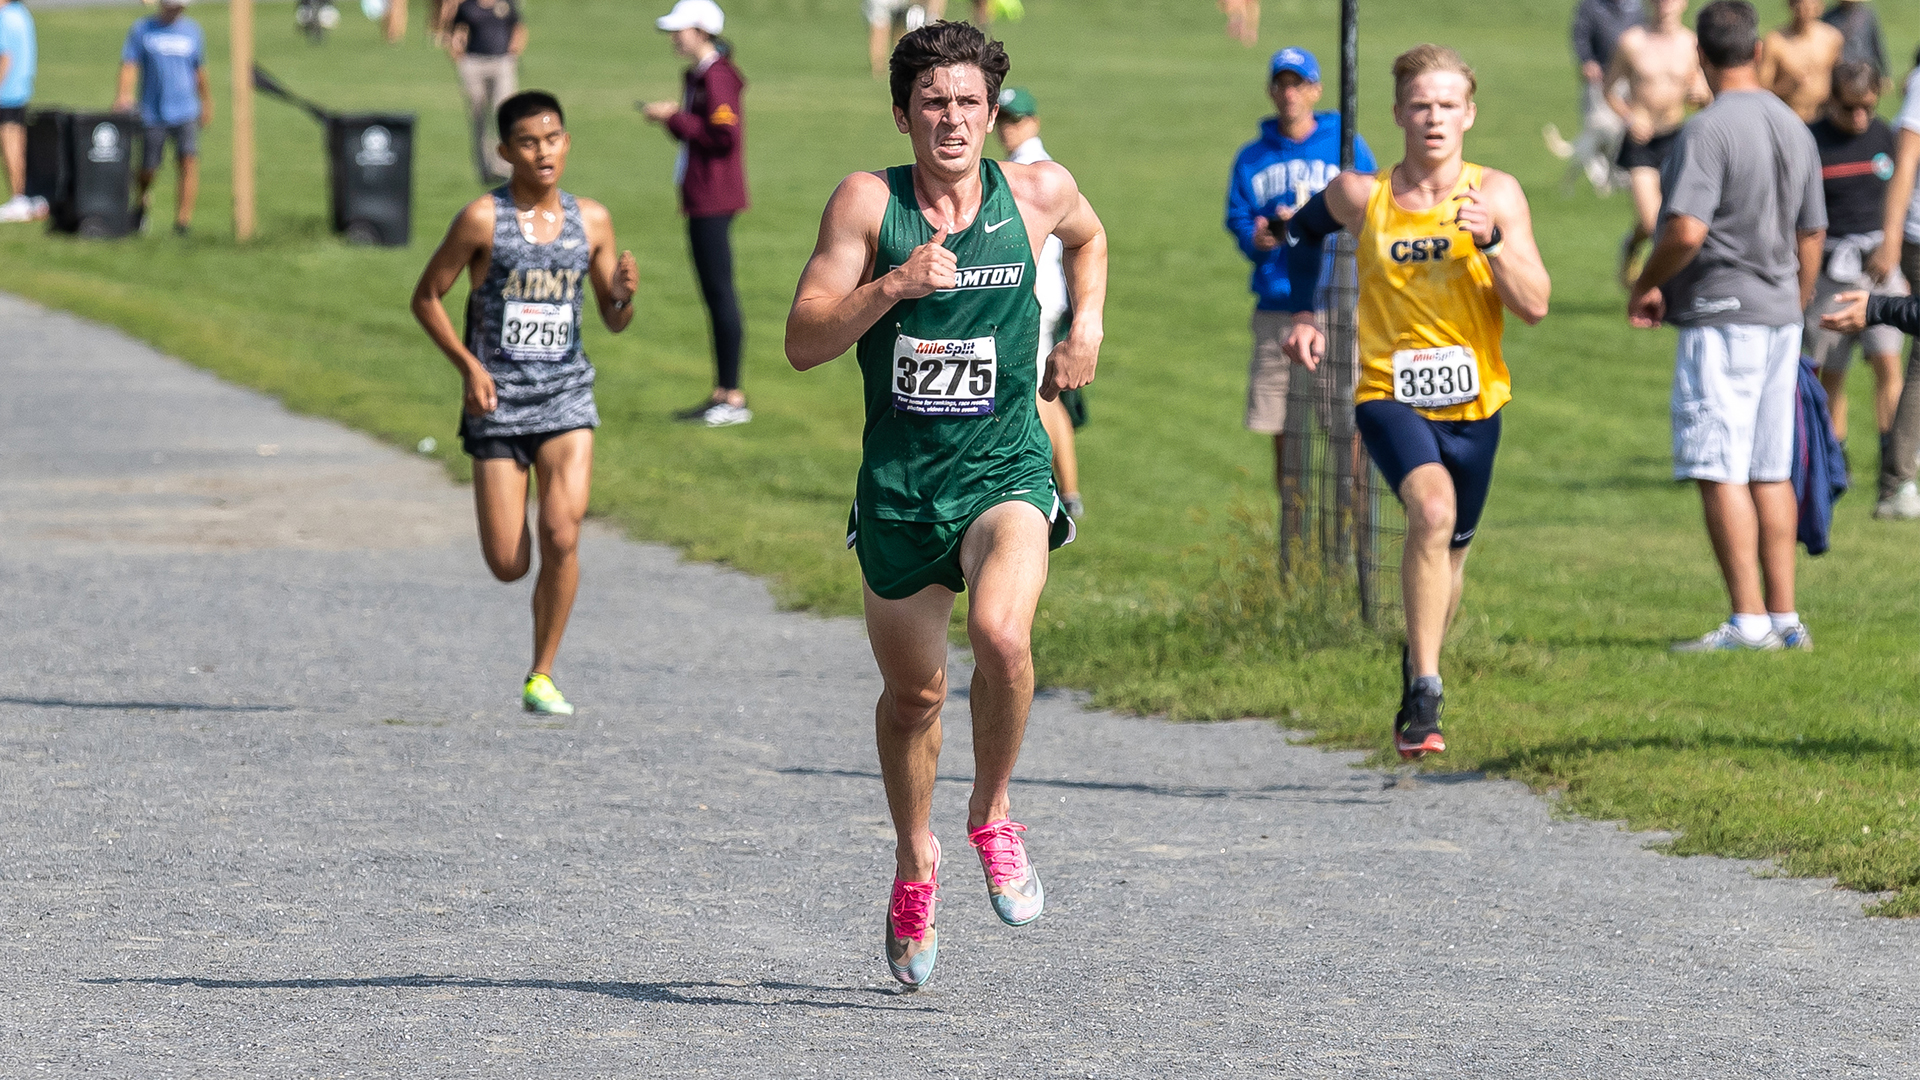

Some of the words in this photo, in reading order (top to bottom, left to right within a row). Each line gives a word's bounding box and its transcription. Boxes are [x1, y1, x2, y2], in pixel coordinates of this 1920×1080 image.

[1390, 238, 1450, 262] CSP
[501, 268, 581, 300] ARMY
[954, 266, 1020, 288] AMTON
[506, 318, 569, 347] 3259
[915, 342, 975, 356] MileSplit
[897, 356, 992, 396] 3275
[1400, 364, 1473, 397] 3330
